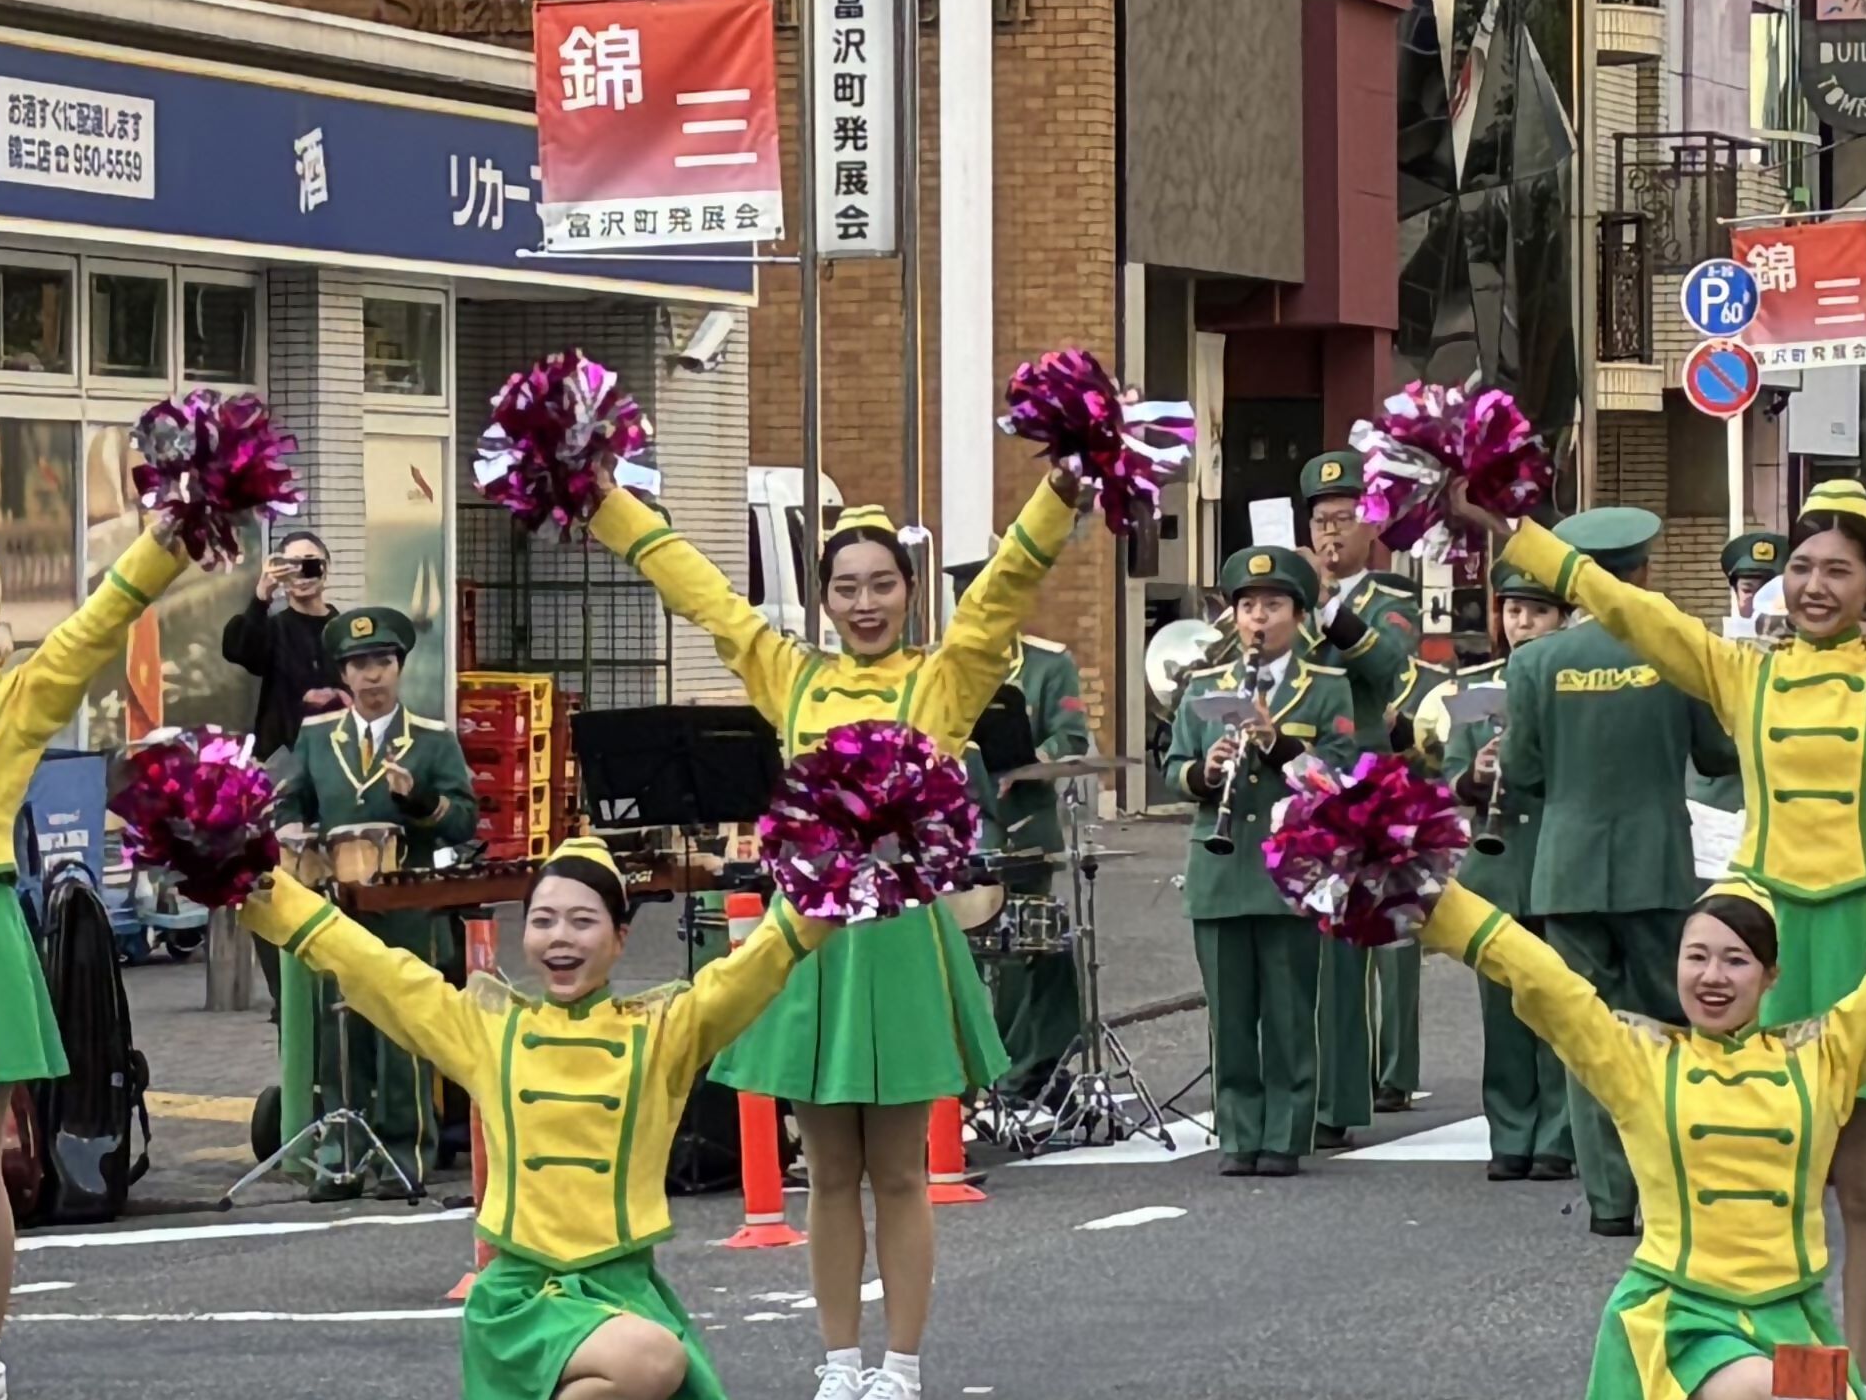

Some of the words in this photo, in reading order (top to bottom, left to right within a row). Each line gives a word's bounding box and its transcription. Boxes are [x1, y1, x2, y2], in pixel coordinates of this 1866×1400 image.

[449, 153, 542, 231] リカー
[565, 202, 761, 239] 富沢町発展会
[1699, 277, 1731, 326] P
